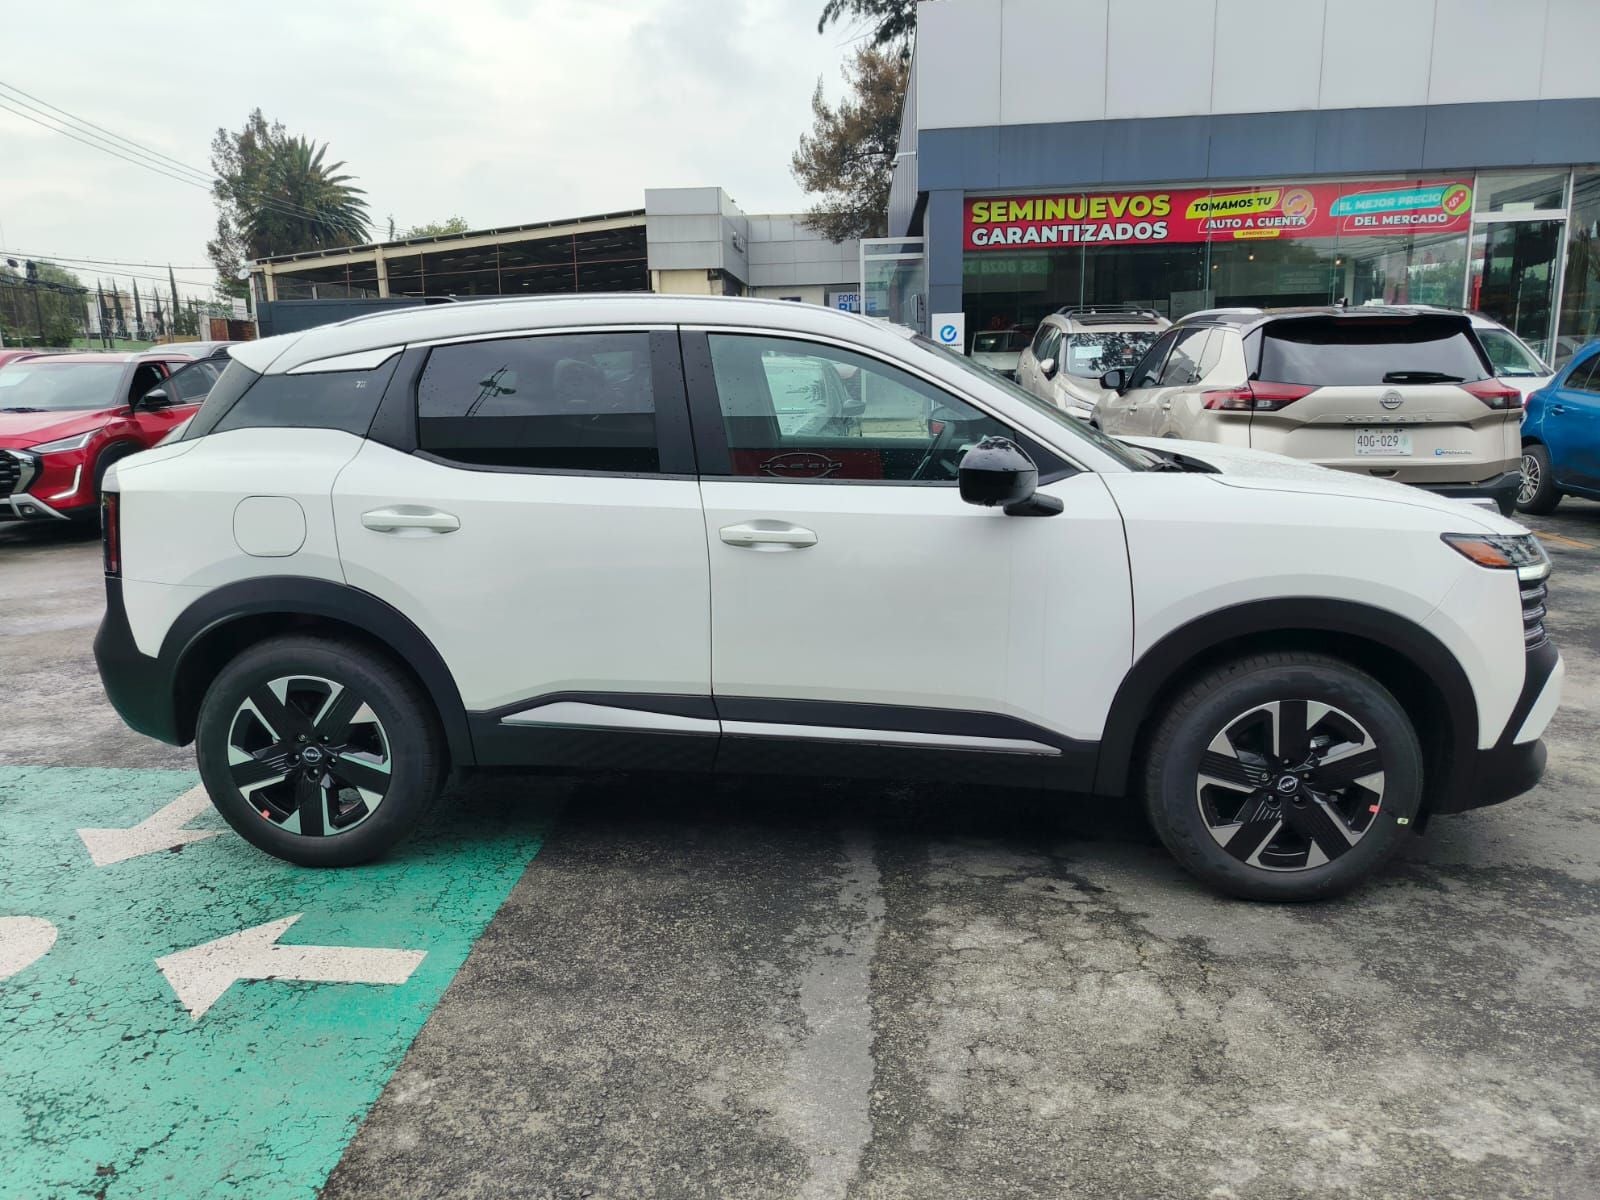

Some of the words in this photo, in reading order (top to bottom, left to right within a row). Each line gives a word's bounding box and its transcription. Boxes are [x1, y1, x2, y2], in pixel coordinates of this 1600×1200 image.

[971, 195, 1170, 223] SEMINUEVOS
[1193, 199, 1253, 212] TOMAMOS
[1257, 196, 1272, 206] TU
[1339, 201, 1352, 211] EL
[1355, 197, 1395, 210] MEJOR
[1398, 193, 1441, 206] PRECIO
[1205, 218, 1242, 229] AUTO
[1244, 217, 1254, 228] A
[1257, 216, 1307, 227] CUENTA
[1354, 216, 1379, 226] DEL
[1382, 213, 1448, 225] MERCADO
[971, 221, 1169, 246] GARANTIZADOS
